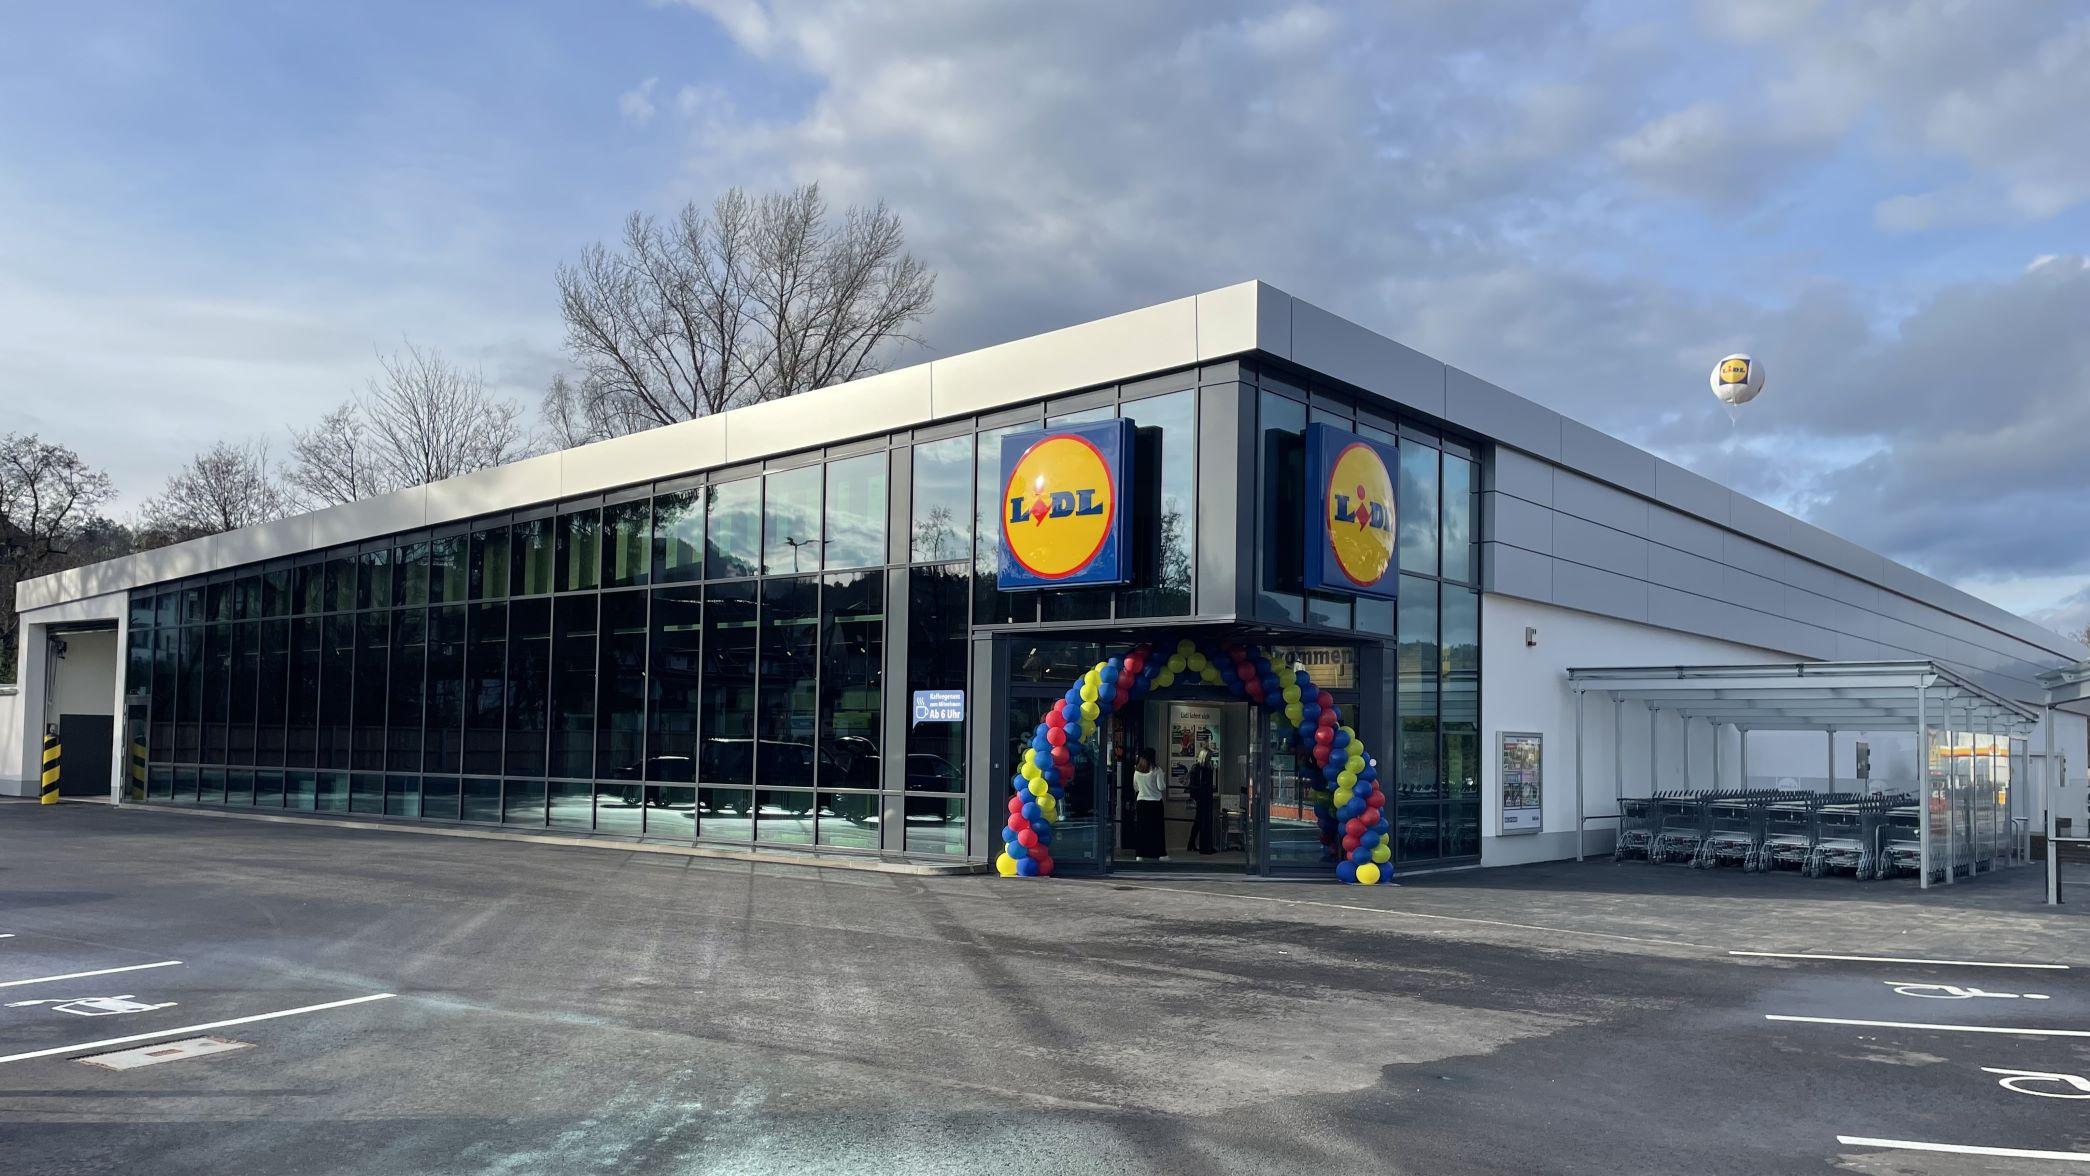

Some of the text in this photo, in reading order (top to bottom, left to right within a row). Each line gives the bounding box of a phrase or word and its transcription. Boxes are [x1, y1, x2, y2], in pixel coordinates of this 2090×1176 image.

[930, 709, 961, 719] Ab 6 Uhr
